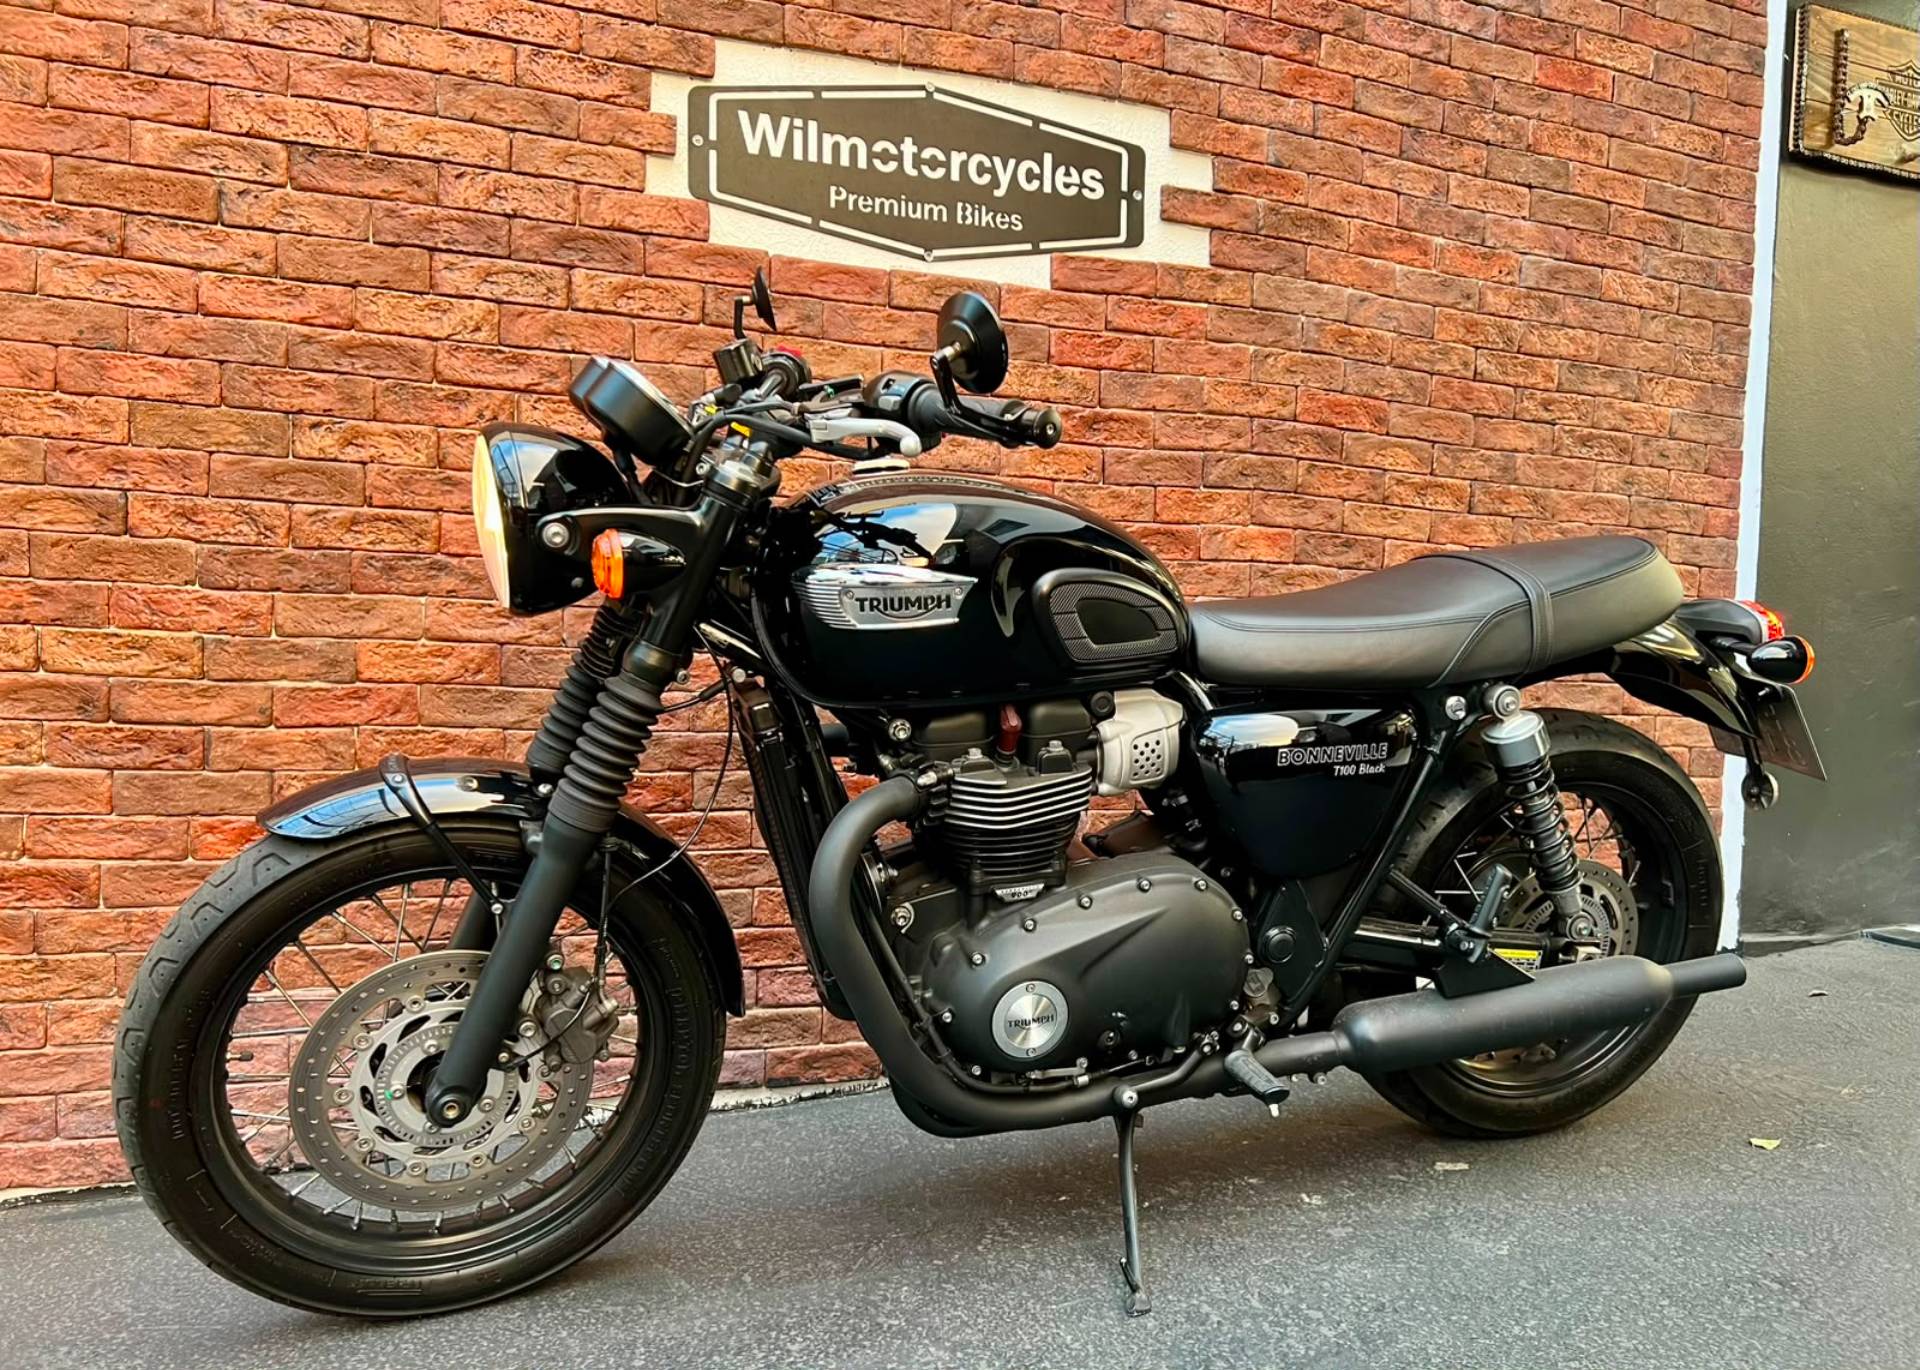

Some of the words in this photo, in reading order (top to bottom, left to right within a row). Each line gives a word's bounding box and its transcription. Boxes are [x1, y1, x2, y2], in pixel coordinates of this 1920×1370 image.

[737, 109, 1105, 199] Wilmotorcycles
[828, 184, 948, 223] Premium
[956, 201, 1023, 231] Bikes
[855, 593, 952, 618] TRIUMPH
[1277, 743, 1387, 766] BONNEVILLE
[1333, 765, 1356, 776] T100
[1358, 763, 1386, 775] Black
[1007, 1014, 1054, 1029] TRIUMPH
